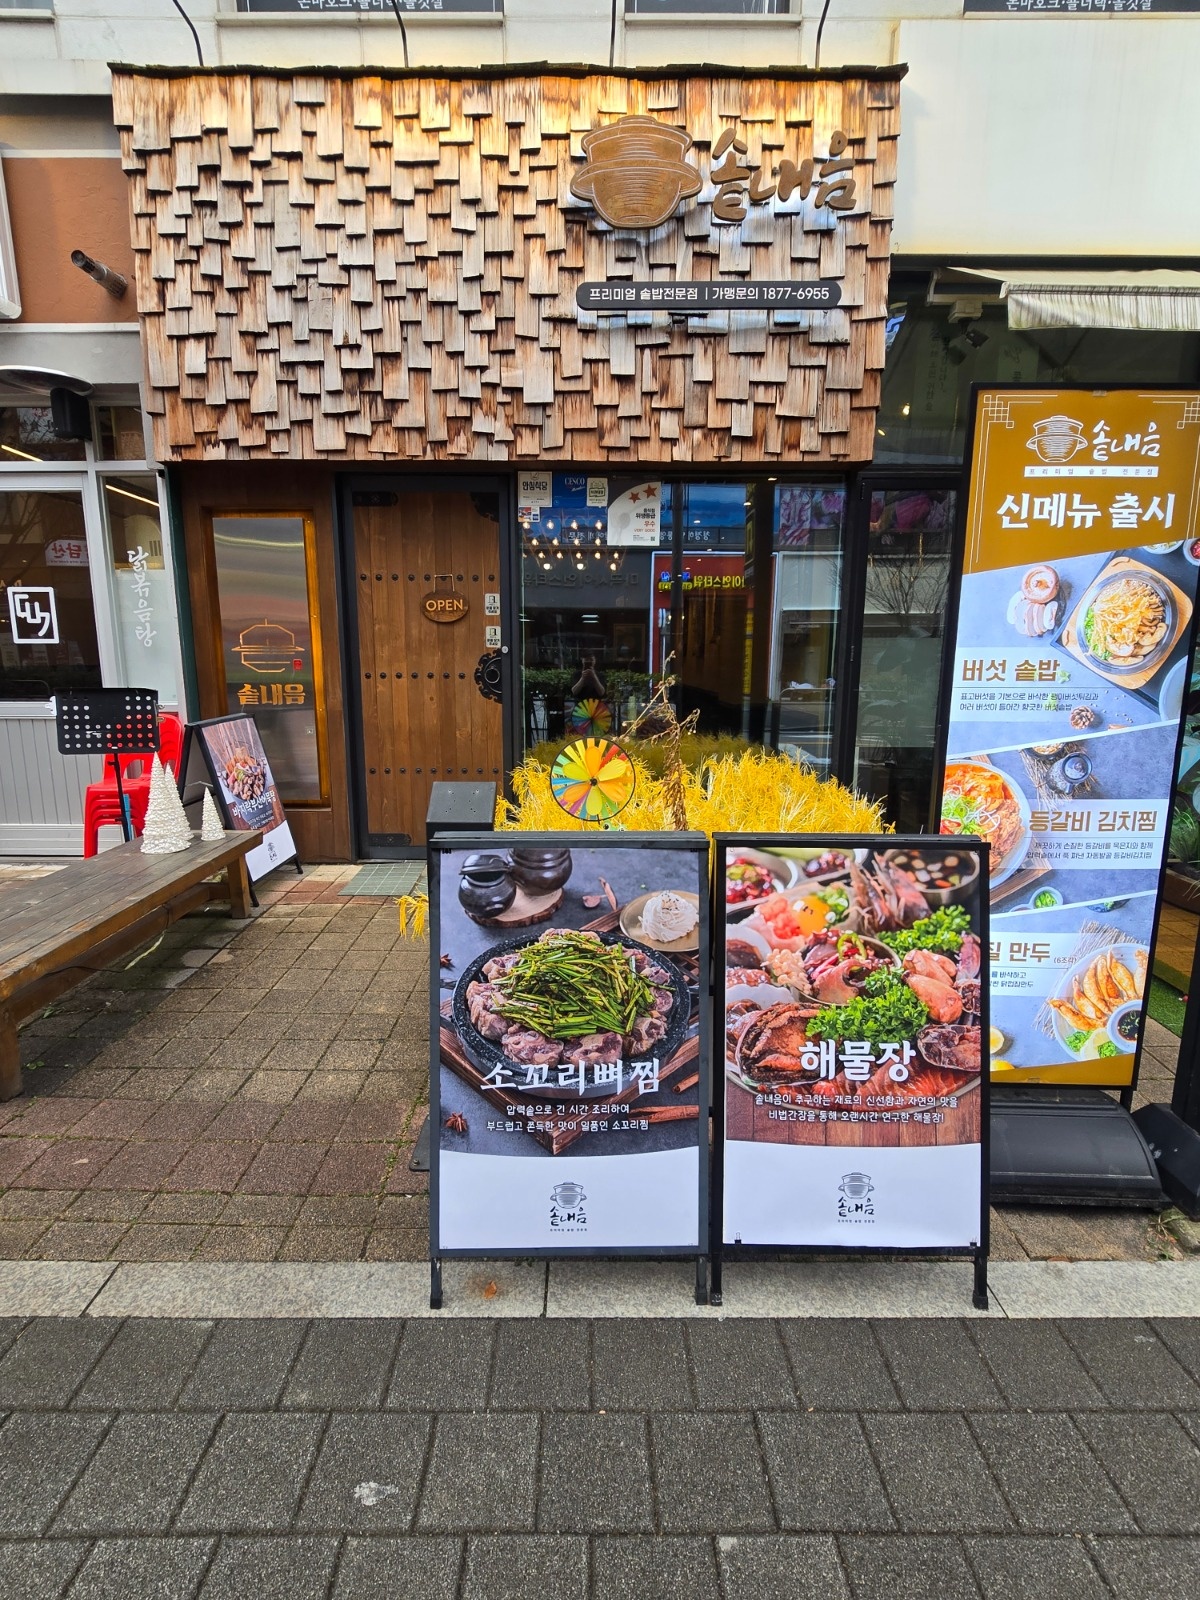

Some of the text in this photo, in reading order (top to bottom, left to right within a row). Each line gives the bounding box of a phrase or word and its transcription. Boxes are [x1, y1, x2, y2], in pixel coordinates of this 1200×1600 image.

[711, 127, 856, 222] 솥내음
[589, 286, 830, 300] 프리미엄 솥밥전문점 가맹문의 1877-6955
[1092, 420, 1160, 461] 솥내음
[522, 481, 548, 491] 안심식당
[564, 477, 586, 486] CESCO
[997, 493, 1176, 529] 신메뉴 출시
[127, 546, 157, 647] 닭볶음탕
[426, 599, 463, 611] OPEN
[962, 659, 1060, 682] 버섯 솥밥
[237, 684, 306, 705] 솥내음
[961, 693, 996, 701] 표고버섯을
[998, 692, 1026, 701] 기본으로
[960, 703, 974, 711] 여러
[976, 703, 997, 711] 버섯이
[1029, 811, 1157, 832] 등갈비 김치찜
[1009, 942, 1050, 963] 만두
[799, 1039, 917, 1082] 해물장
[480, 1058, 660, 1096] 소꼬리뼈찜
[507, 1103, 630, 1116] 압력솥으로 긴 시간 조리하여
[755, 1094, 958, 1108] 솥내음이 추구하는 재료의 신선함과 자연의 맛을
[487, 1119, 649, 1133] 부드럽고 쫀득한 맛이 일품인 소꼬리찜
[769, 1110, 944, 1124] 비법간장을 통해 오랜시간 연구한 해물장!
[550, 1206, 587, 1226] 솥내음
[838, 1196, 875, 1217] 솥내음
